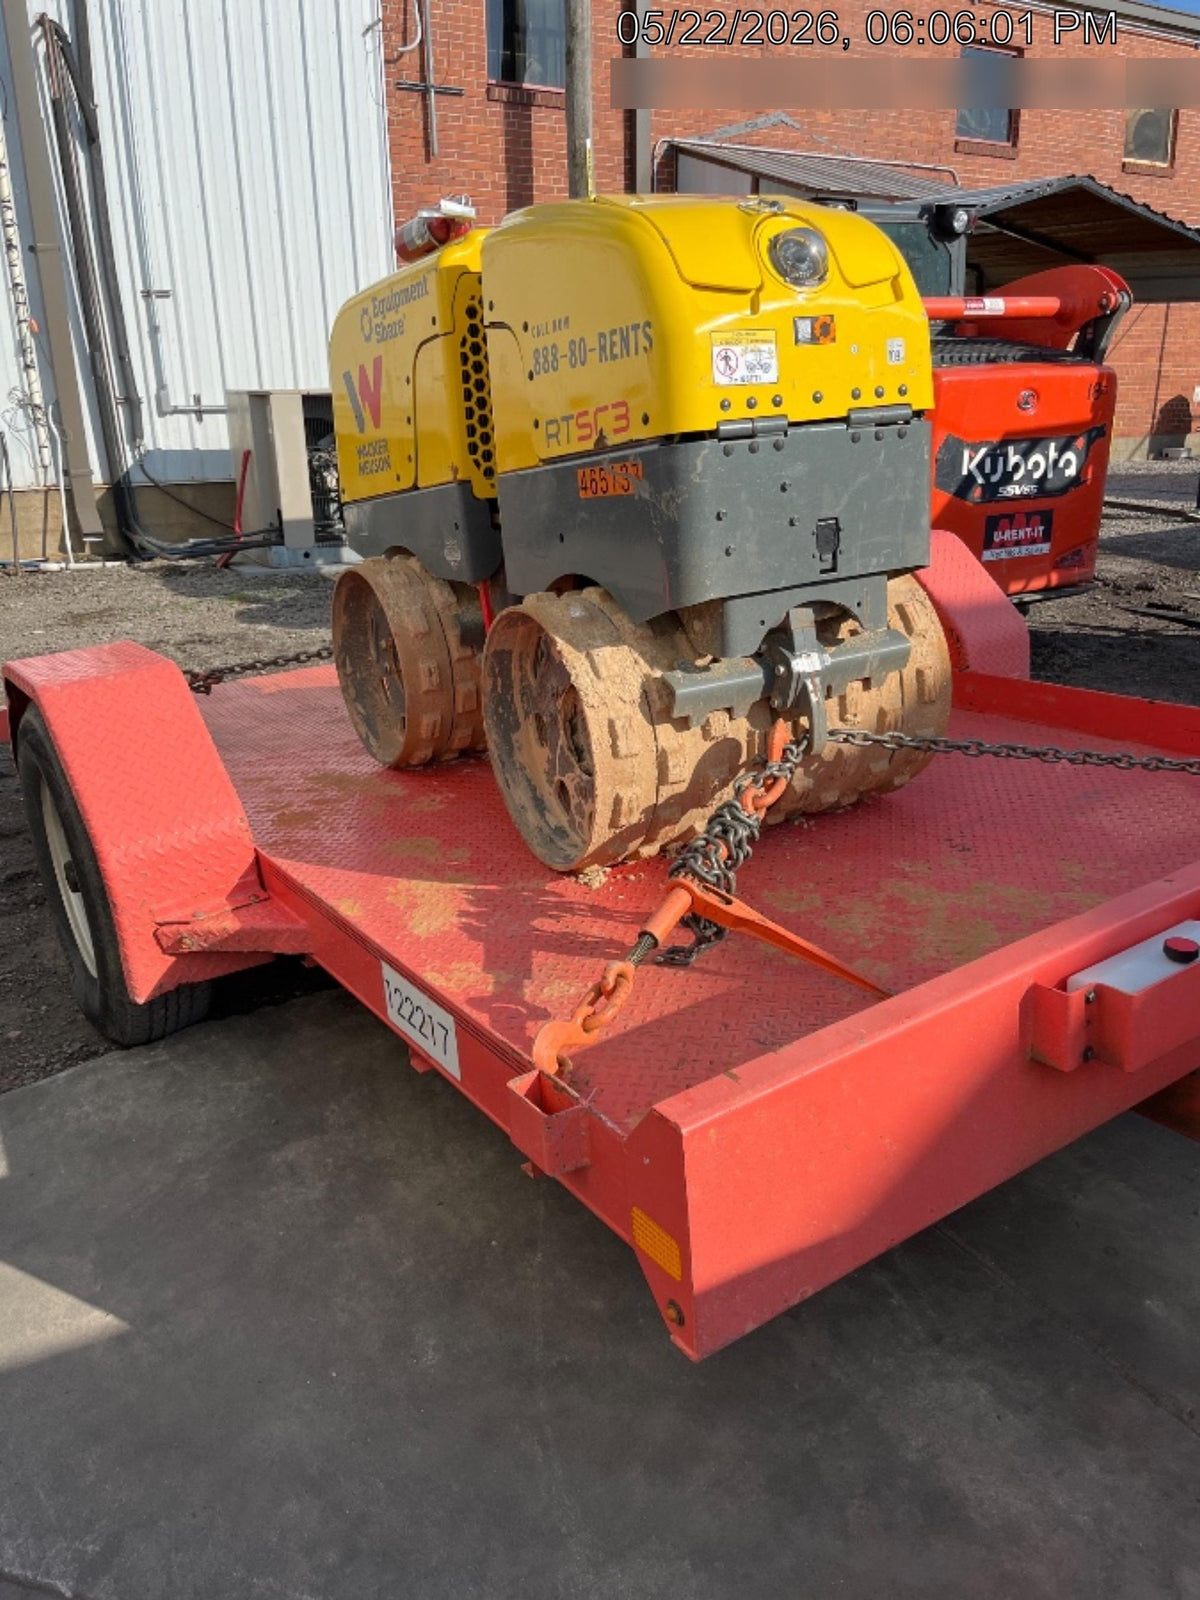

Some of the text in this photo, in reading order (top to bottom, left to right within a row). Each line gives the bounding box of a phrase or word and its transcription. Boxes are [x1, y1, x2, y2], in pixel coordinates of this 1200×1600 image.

[371, 277, 429, 319] Equipment
[533, 320, 653, 375] 888-80-RENTS
[961, 442, 1077, 485] Kubota
[993, 525, 1045, 542] U-RENT-IT
[385, 978, 449, 1057] 122217
